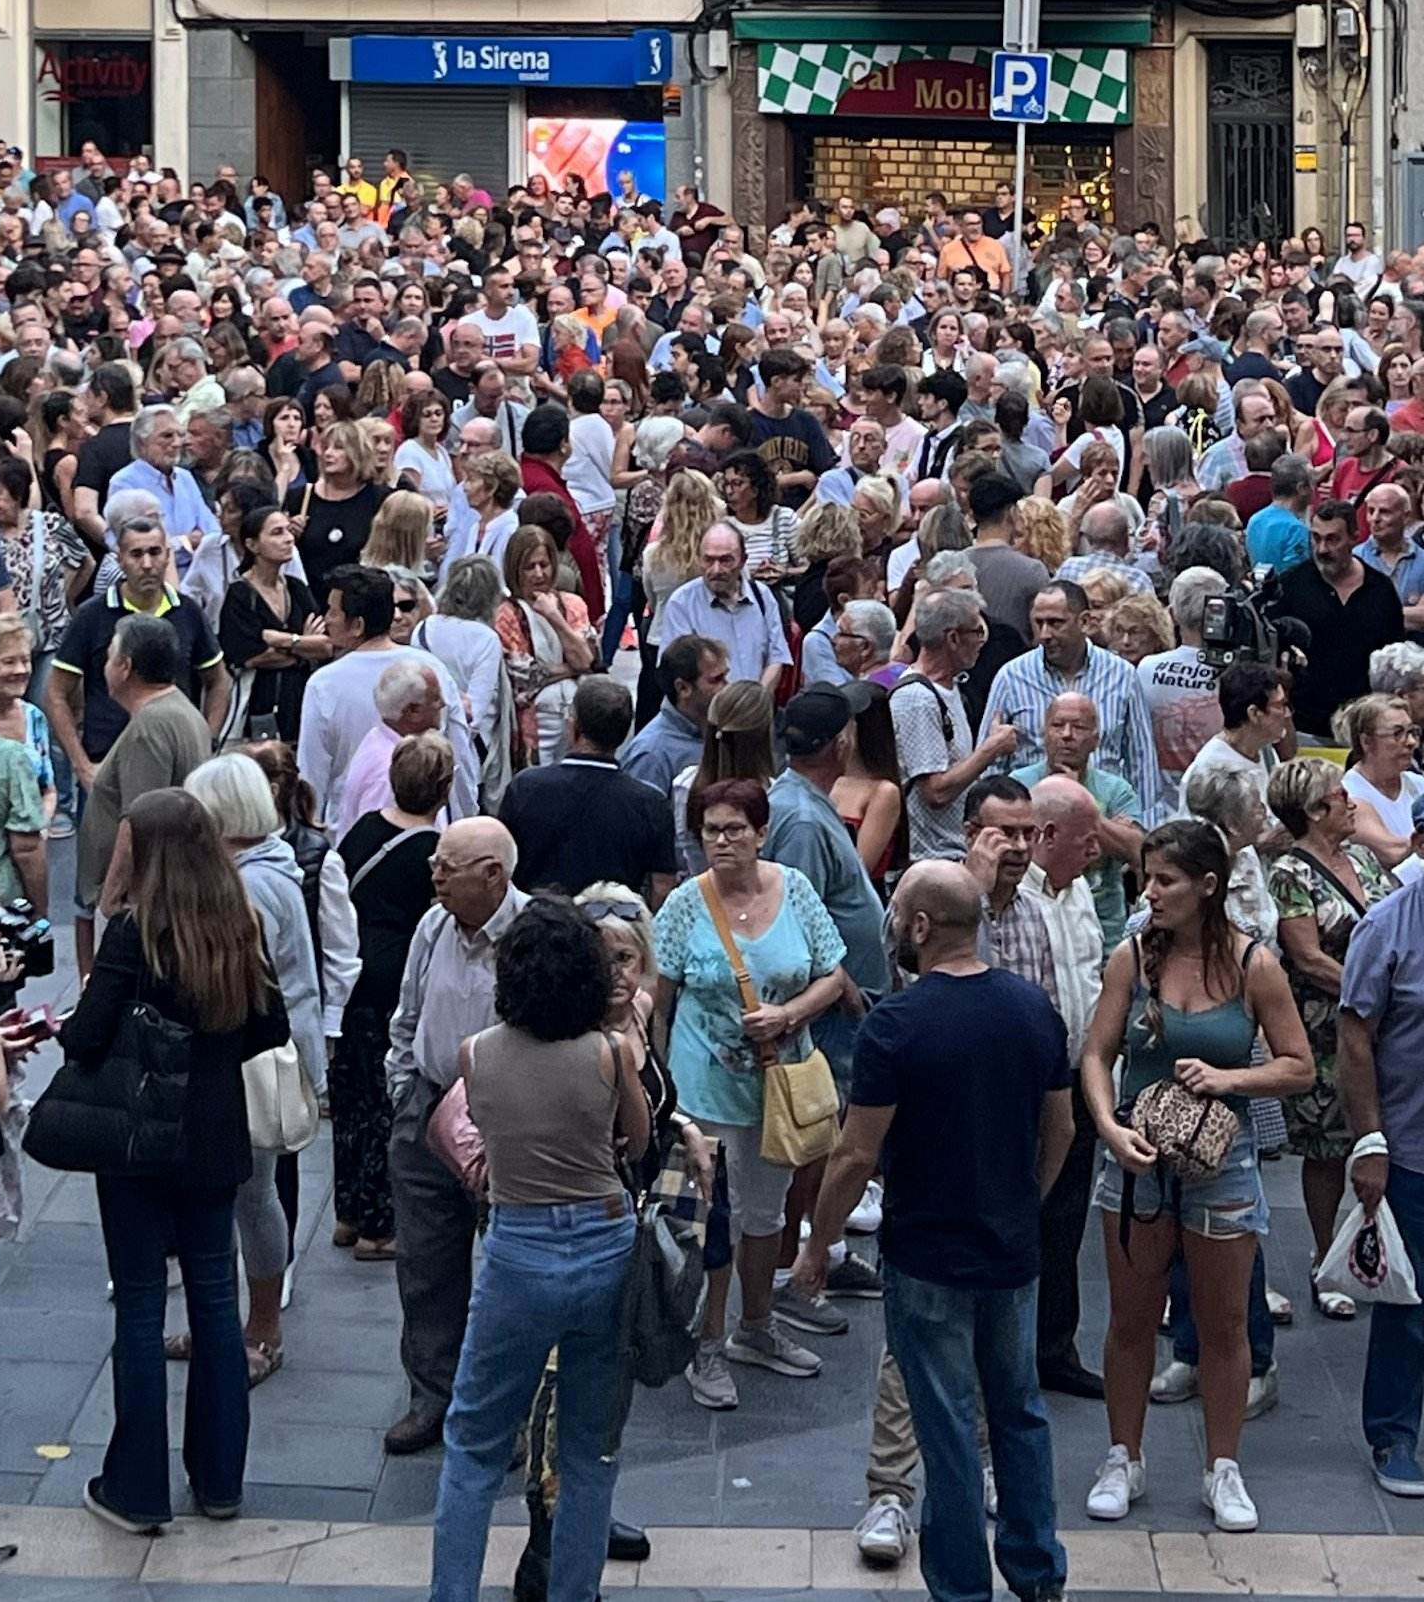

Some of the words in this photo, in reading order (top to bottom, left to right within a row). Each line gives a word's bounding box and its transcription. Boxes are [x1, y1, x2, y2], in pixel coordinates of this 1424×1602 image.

[457, 45, 476, 70] la
[480, 45, 550, 70] Sirena
[848, 61, 896, 91] Cal
[1003, 60, 1037, 112] P
[1152, 673, 1217, 691] Nature
[1155, 661, 1221, 681] #Enjoy
